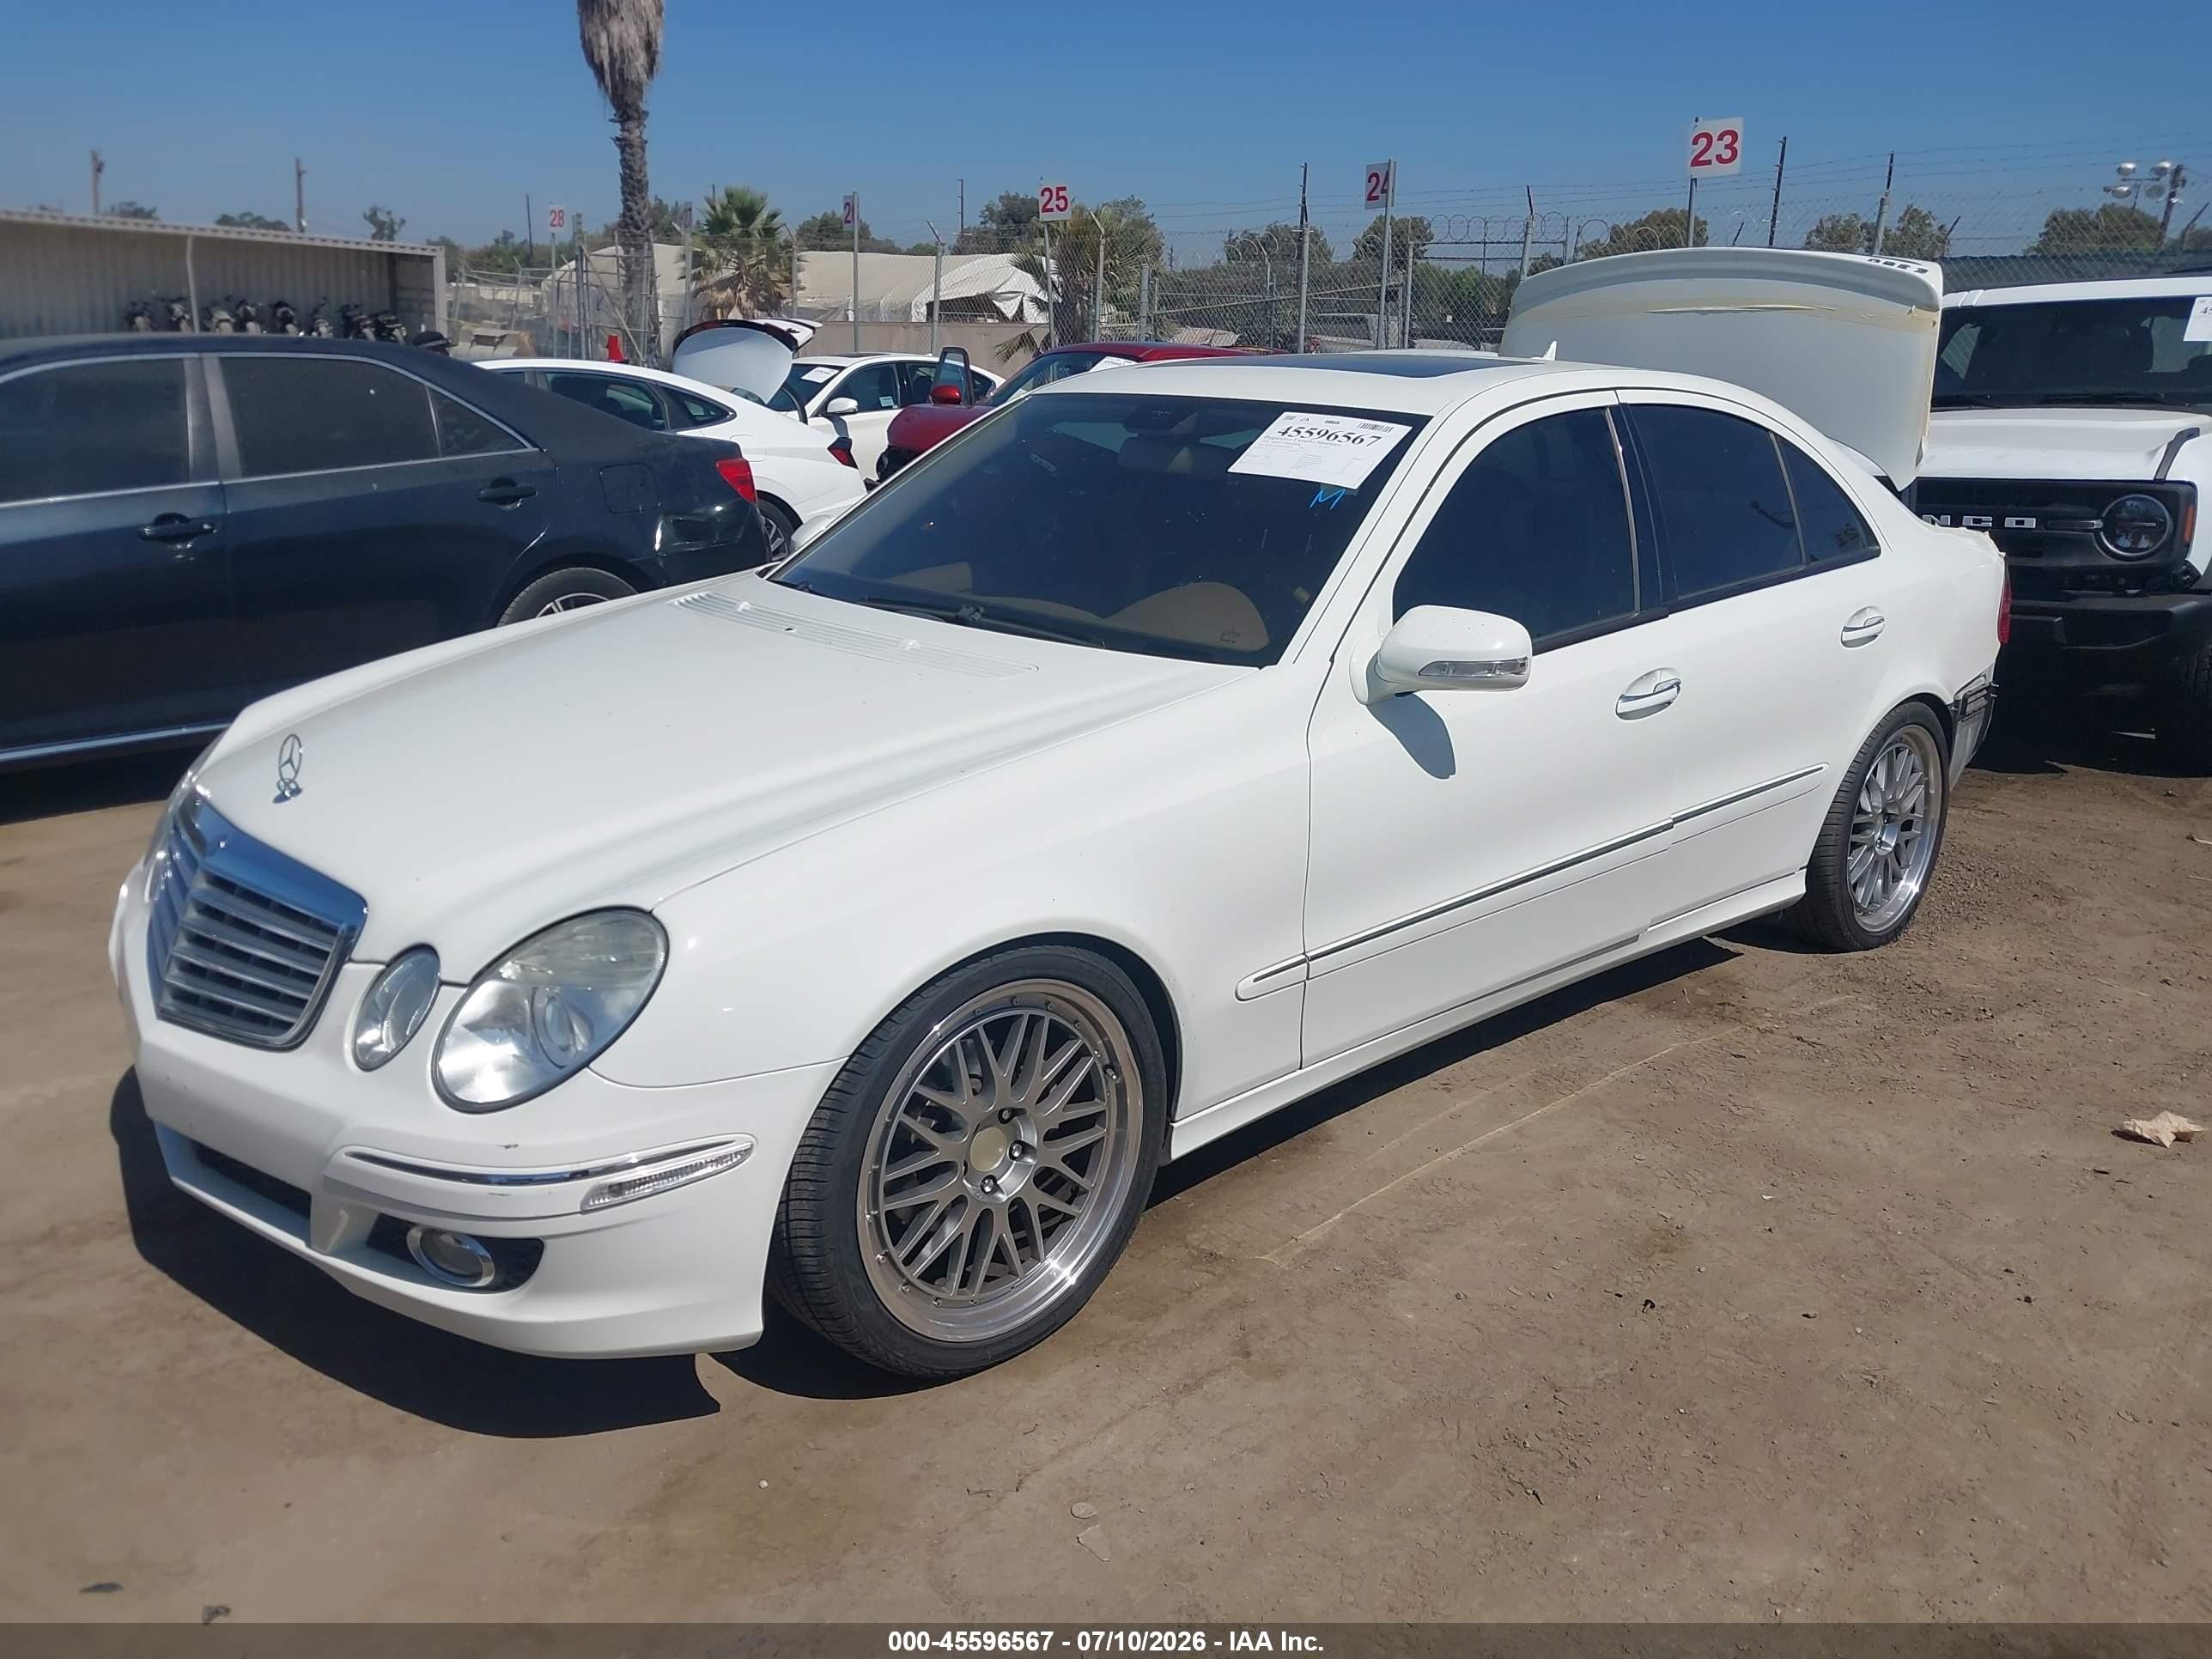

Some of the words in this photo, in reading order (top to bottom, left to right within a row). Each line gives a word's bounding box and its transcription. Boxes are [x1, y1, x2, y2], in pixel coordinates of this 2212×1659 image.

[1690, 129, 1739, 167] 23
[1040, 185, 1069, 213] 25
[550, 209, 565, 228] 28
[843, 201, 854, 224] 2
[1277, 425, 1384, 447] 45596567
[1309, 489, 1346, 510] M
